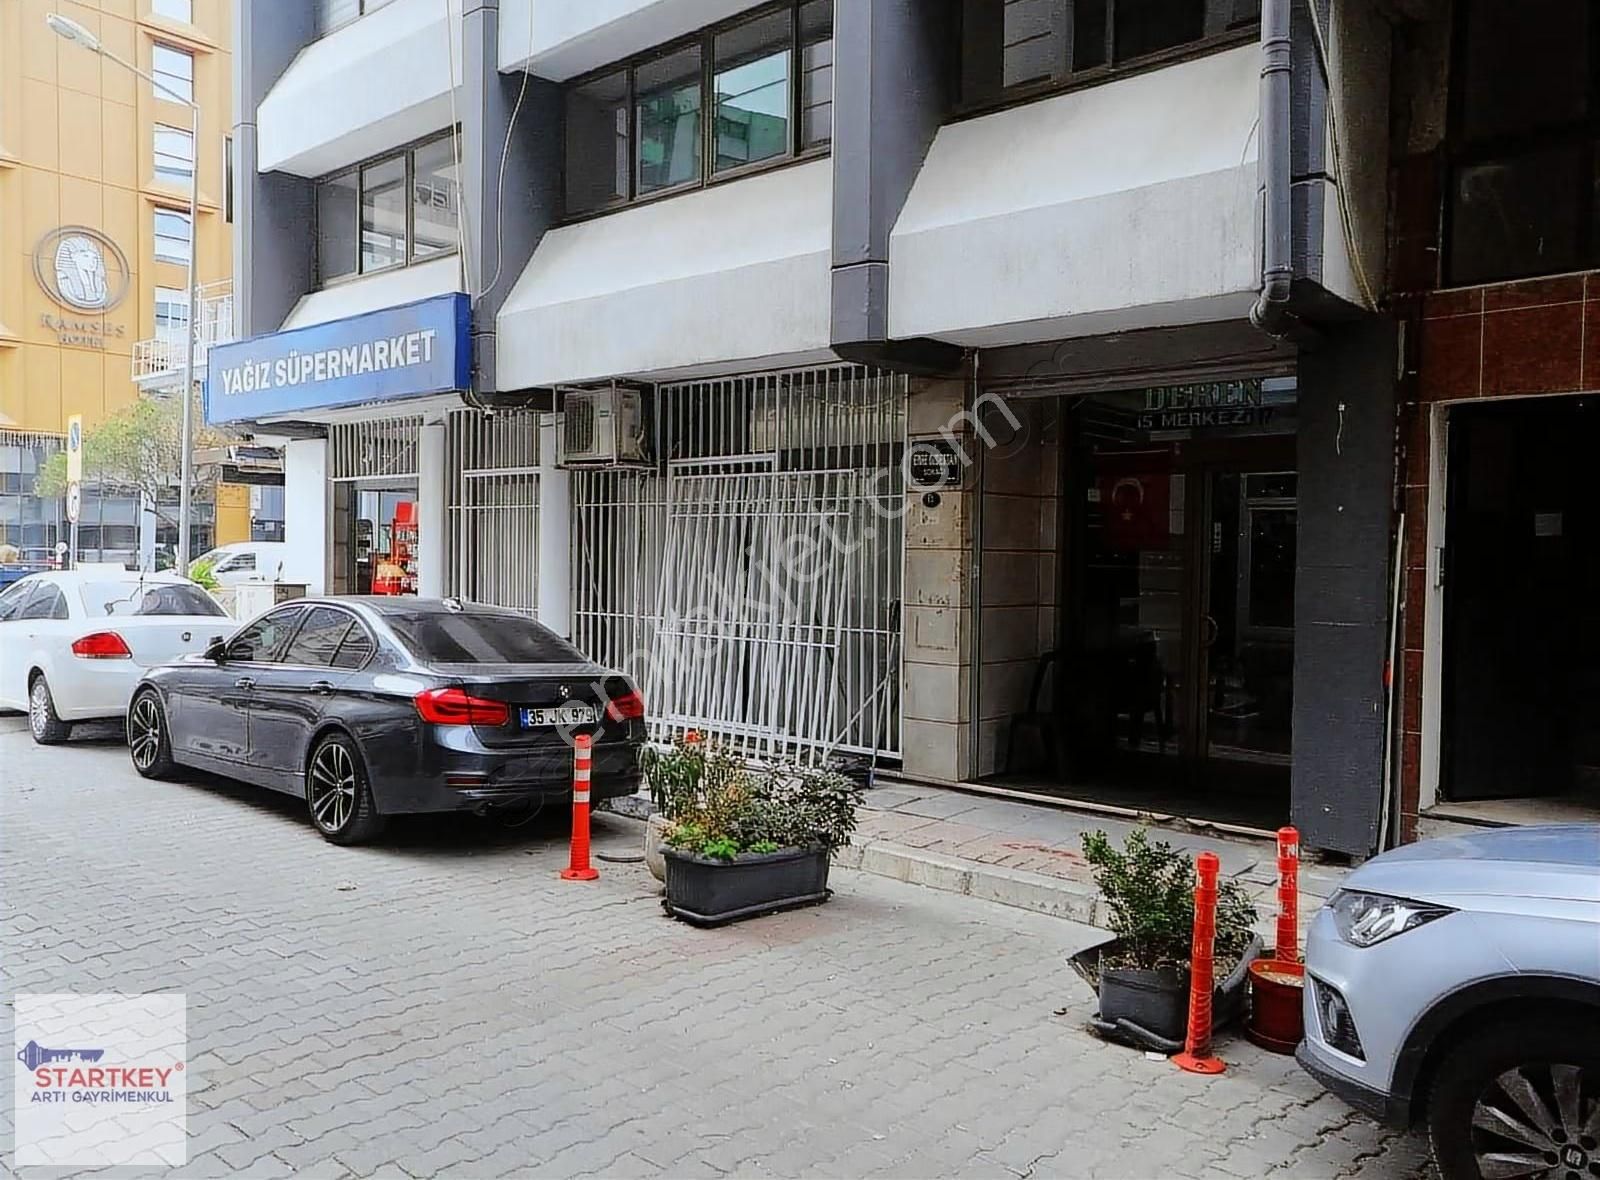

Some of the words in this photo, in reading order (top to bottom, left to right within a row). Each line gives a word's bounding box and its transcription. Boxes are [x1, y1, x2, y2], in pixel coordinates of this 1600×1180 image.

[221, 360, 271, 396] YAĞIZ
[275, 328, 436, 386] SÜPERMARKET
[528, 709, 544, 725] 35
